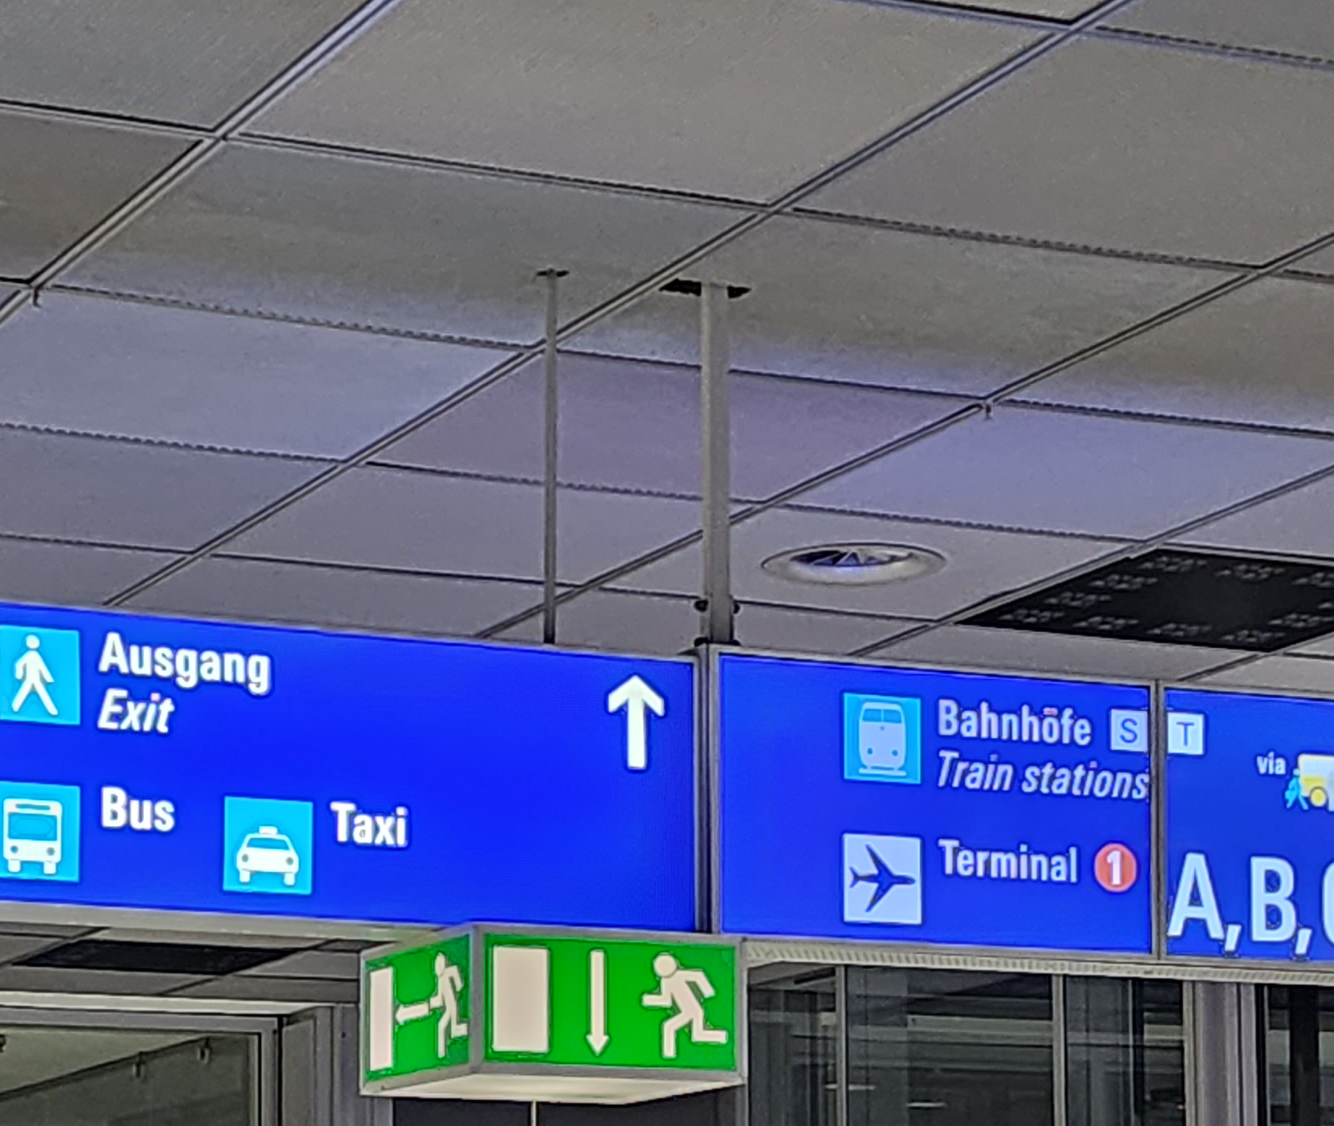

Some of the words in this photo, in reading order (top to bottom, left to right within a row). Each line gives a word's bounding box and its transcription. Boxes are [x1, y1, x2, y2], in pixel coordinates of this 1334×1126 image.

[98, 632, 270, 694] Ausgang
[97, 688, 174, 733] Exit
[937, 698, 1092, 746] Bahnhöfe
[1119, 718, 1138, 744] S
[1176, 721, 1195, 747] T
[937, 750, 1013, 793] Train
[1021, 761, 1150, 800] stations
[1257, 751, 1286, 776] via
[101, 786, 175, 832] Bus
[330, 802, 407, 847] Taxi
[938, 838, 1078, 884] Terminal
[1106, 850, 1122, 886] 1
